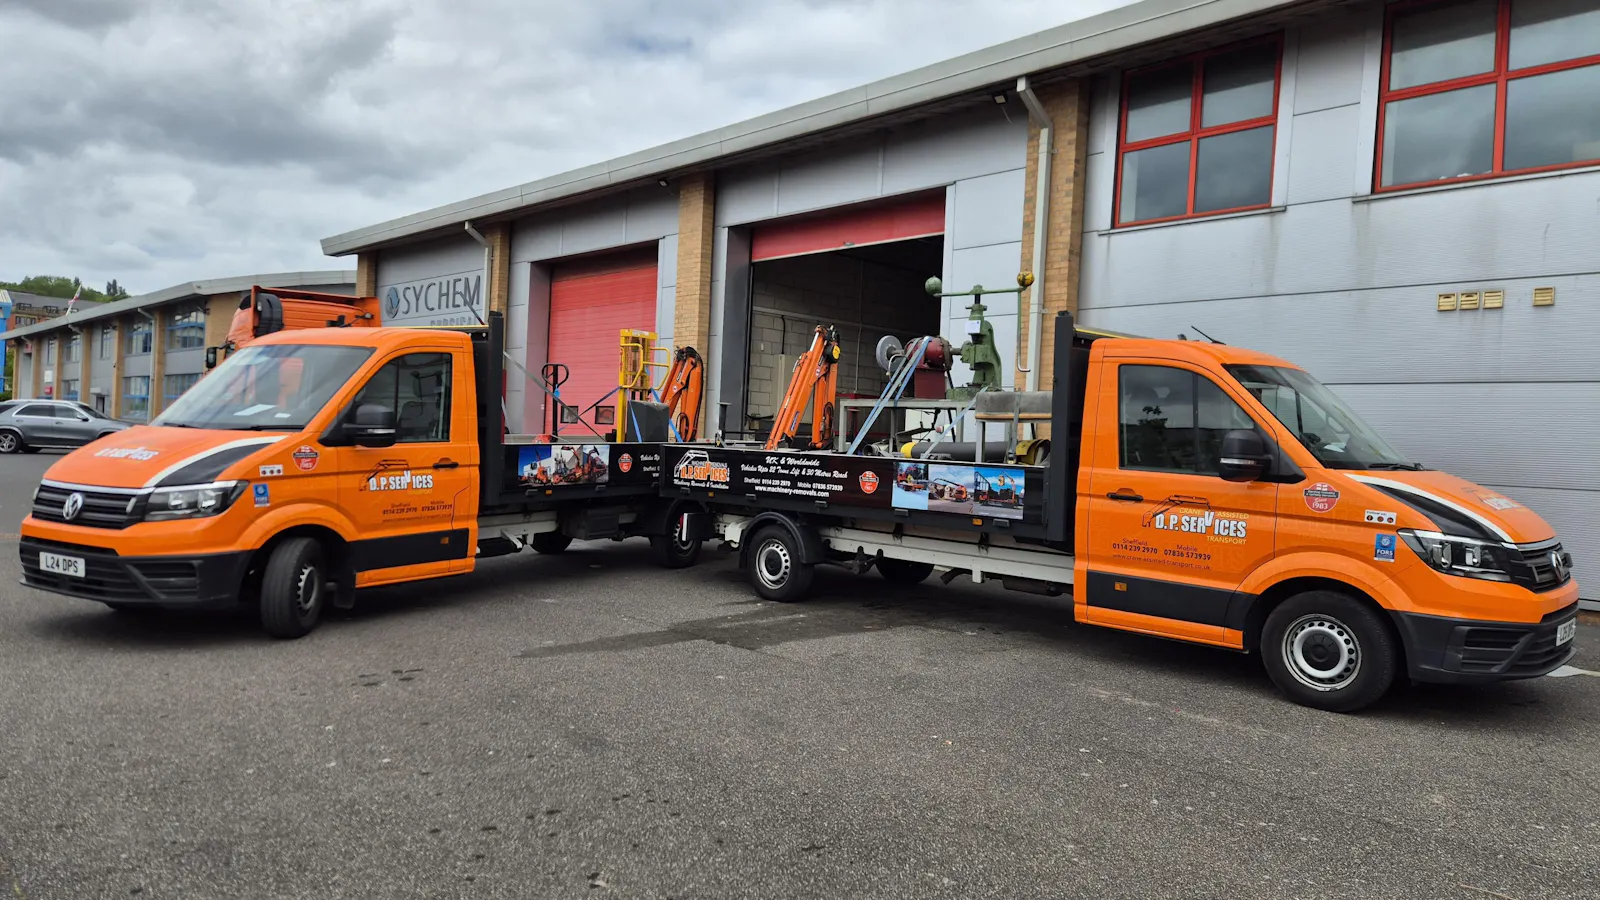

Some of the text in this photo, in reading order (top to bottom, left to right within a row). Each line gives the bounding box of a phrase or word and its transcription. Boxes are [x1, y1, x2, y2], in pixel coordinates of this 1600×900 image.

[402, 275, 480, 315] SYCHEM
[765, 456, 820, 466] UK & Worldwide
[389, 470, 434, 490] SERVICES
[797, 481, 811, 489] Mobile
[812, 482, 826, 490] 07836
[755, 485, 829, 497] www.machinery-removals.com
[1179, 507, 1249, 519] CRANE ASSISTED
[1180, 510, 1247, 538] SERVICES
[1122, 537, 1198, 552] Sheffield Mobile
[1206, 535, 1247, 545] TRANSPORT
[1112, 543, 1128, 551] 0114
[1142, 546, 1158, 555] 2970
[1163, 549, 1184, 558] 07836
[1186, 551, 1211, 561] 573939
[1376, 548, 1393, 556] FORS
[45, 555, 78, 573] L24 DPS
